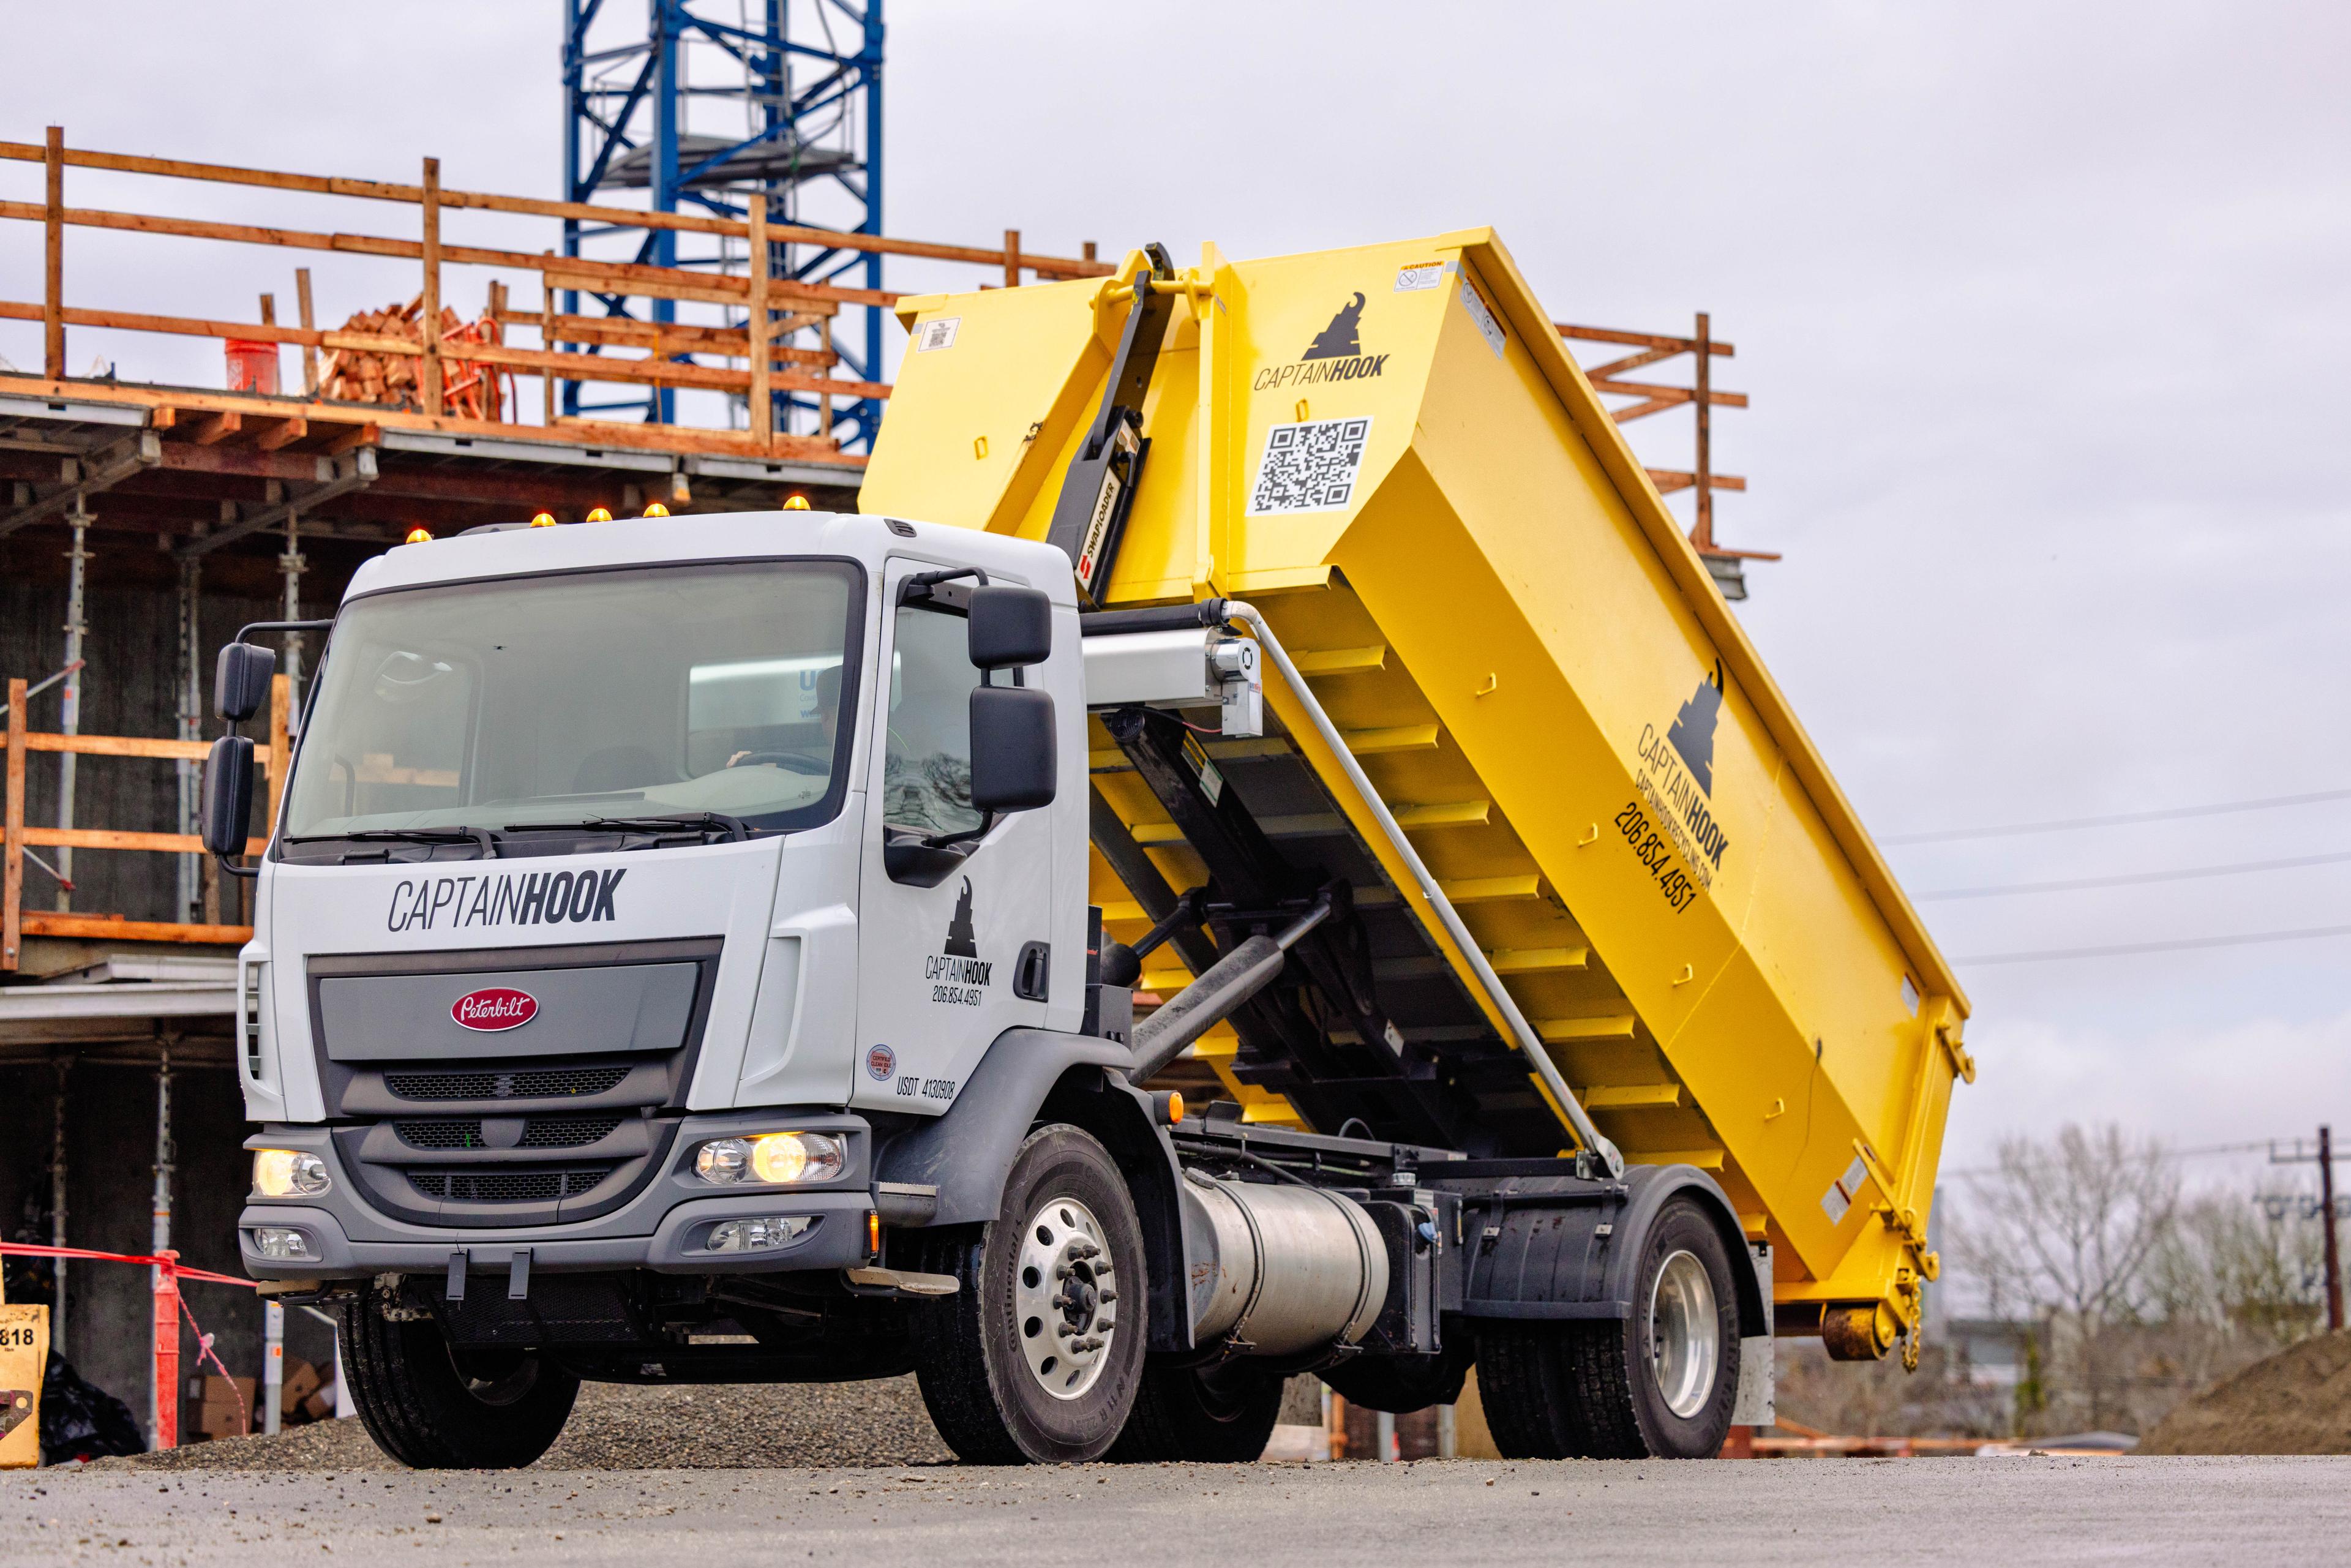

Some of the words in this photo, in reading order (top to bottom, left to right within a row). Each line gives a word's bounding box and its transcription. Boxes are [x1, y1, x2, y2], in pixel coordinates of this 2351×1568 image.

[1409, 261, 1442, 269] CAUTION
[1254, 354, 1390, 391] CAPTAINHOOK
[1087, 482, 1114, 558] SWAPLOADER
[1638, 722, 1729, 872] CAPTAINHOOK
[1614, 801, 1697, 915] 206.854.4951
[388, 868, 628, 932] CAPTAINHOOK
[925, 955, 992, 986] CAPTAINHOOK
[460, 996, 530, 1021] Peterbilt
[932, 985, 983, 1007] 206.854.4951
[896, 1076, 920, 1097] USDT
[921, 1078, 956, 1100] 4130908
